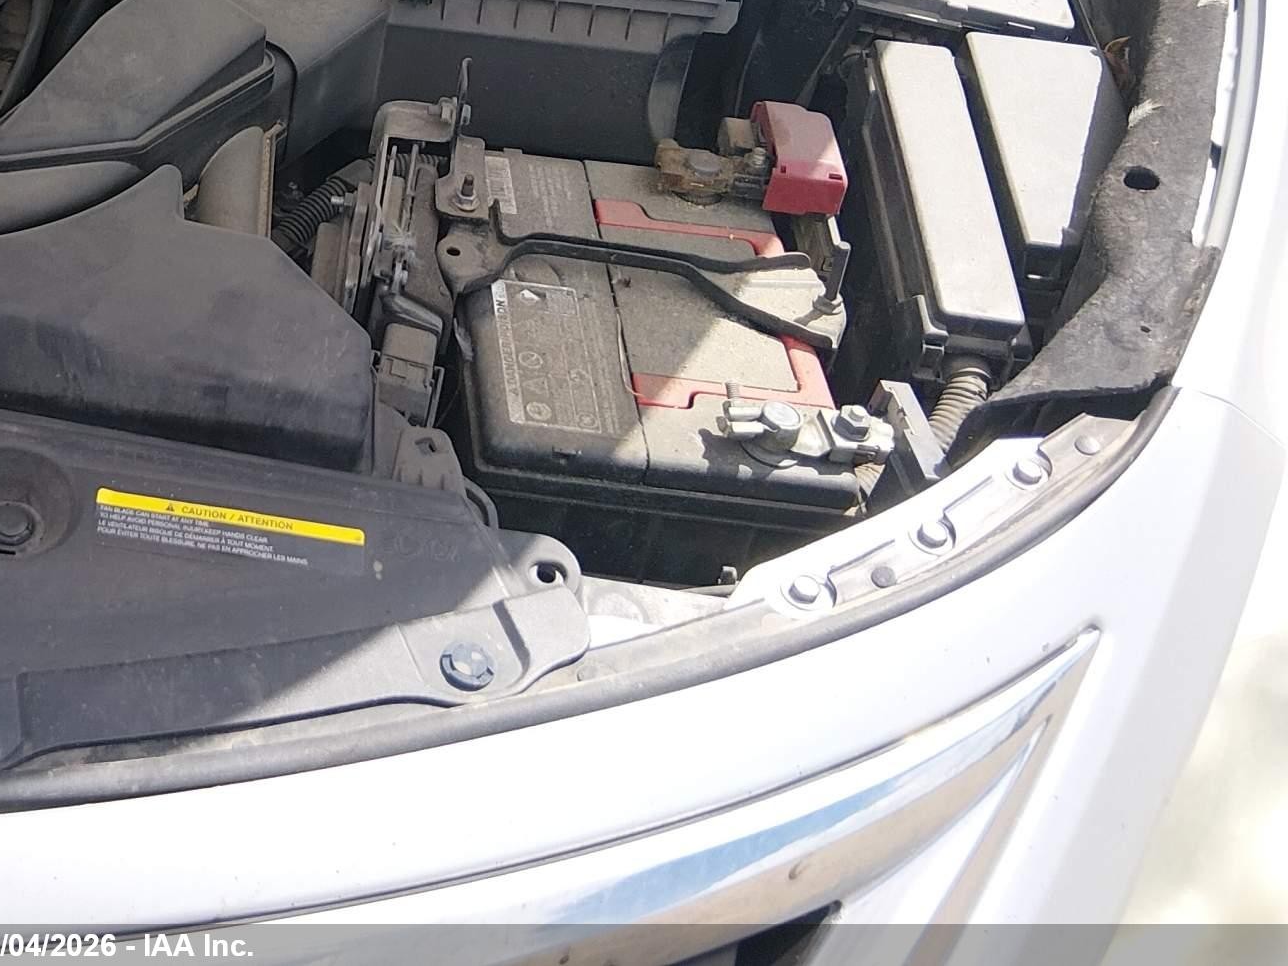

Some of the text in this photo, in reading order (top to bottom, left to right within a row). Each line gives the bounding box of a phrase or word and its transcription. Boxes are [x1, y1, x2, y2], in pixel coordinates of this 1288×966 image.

[180, 505, 293, 530] CAUTION / ATTENTION
